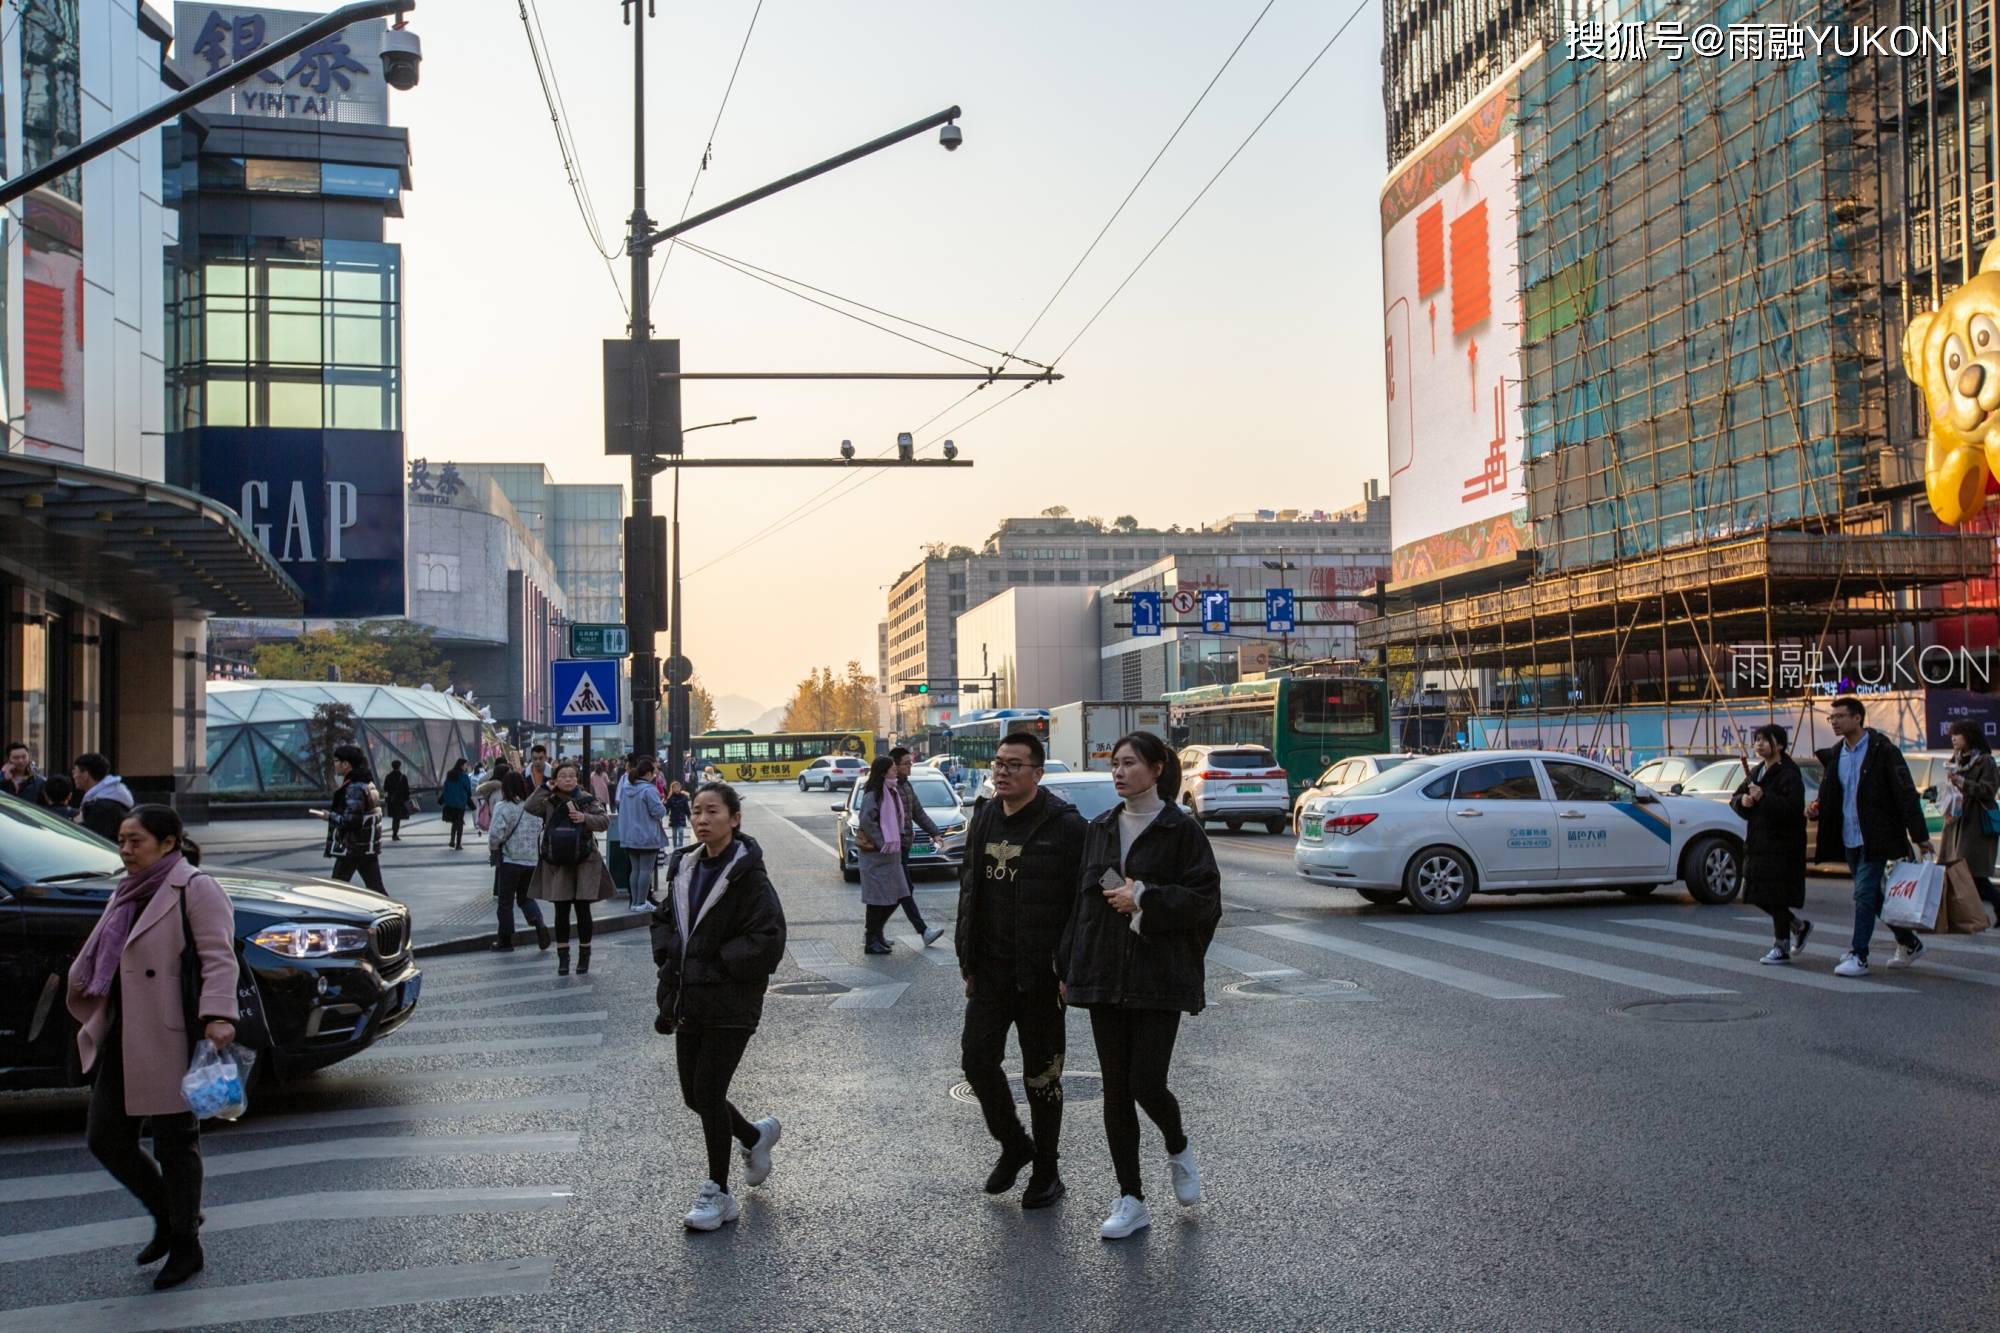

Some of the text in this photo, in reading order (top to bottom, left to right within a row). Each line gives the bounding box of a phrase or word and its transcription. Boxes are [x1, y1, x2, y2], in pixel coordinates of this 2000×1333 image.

[242, 91, 328, 114] YINTAI
[241, 480, 358, 563] GAP
[986, 865, 1018, 882] BOY
